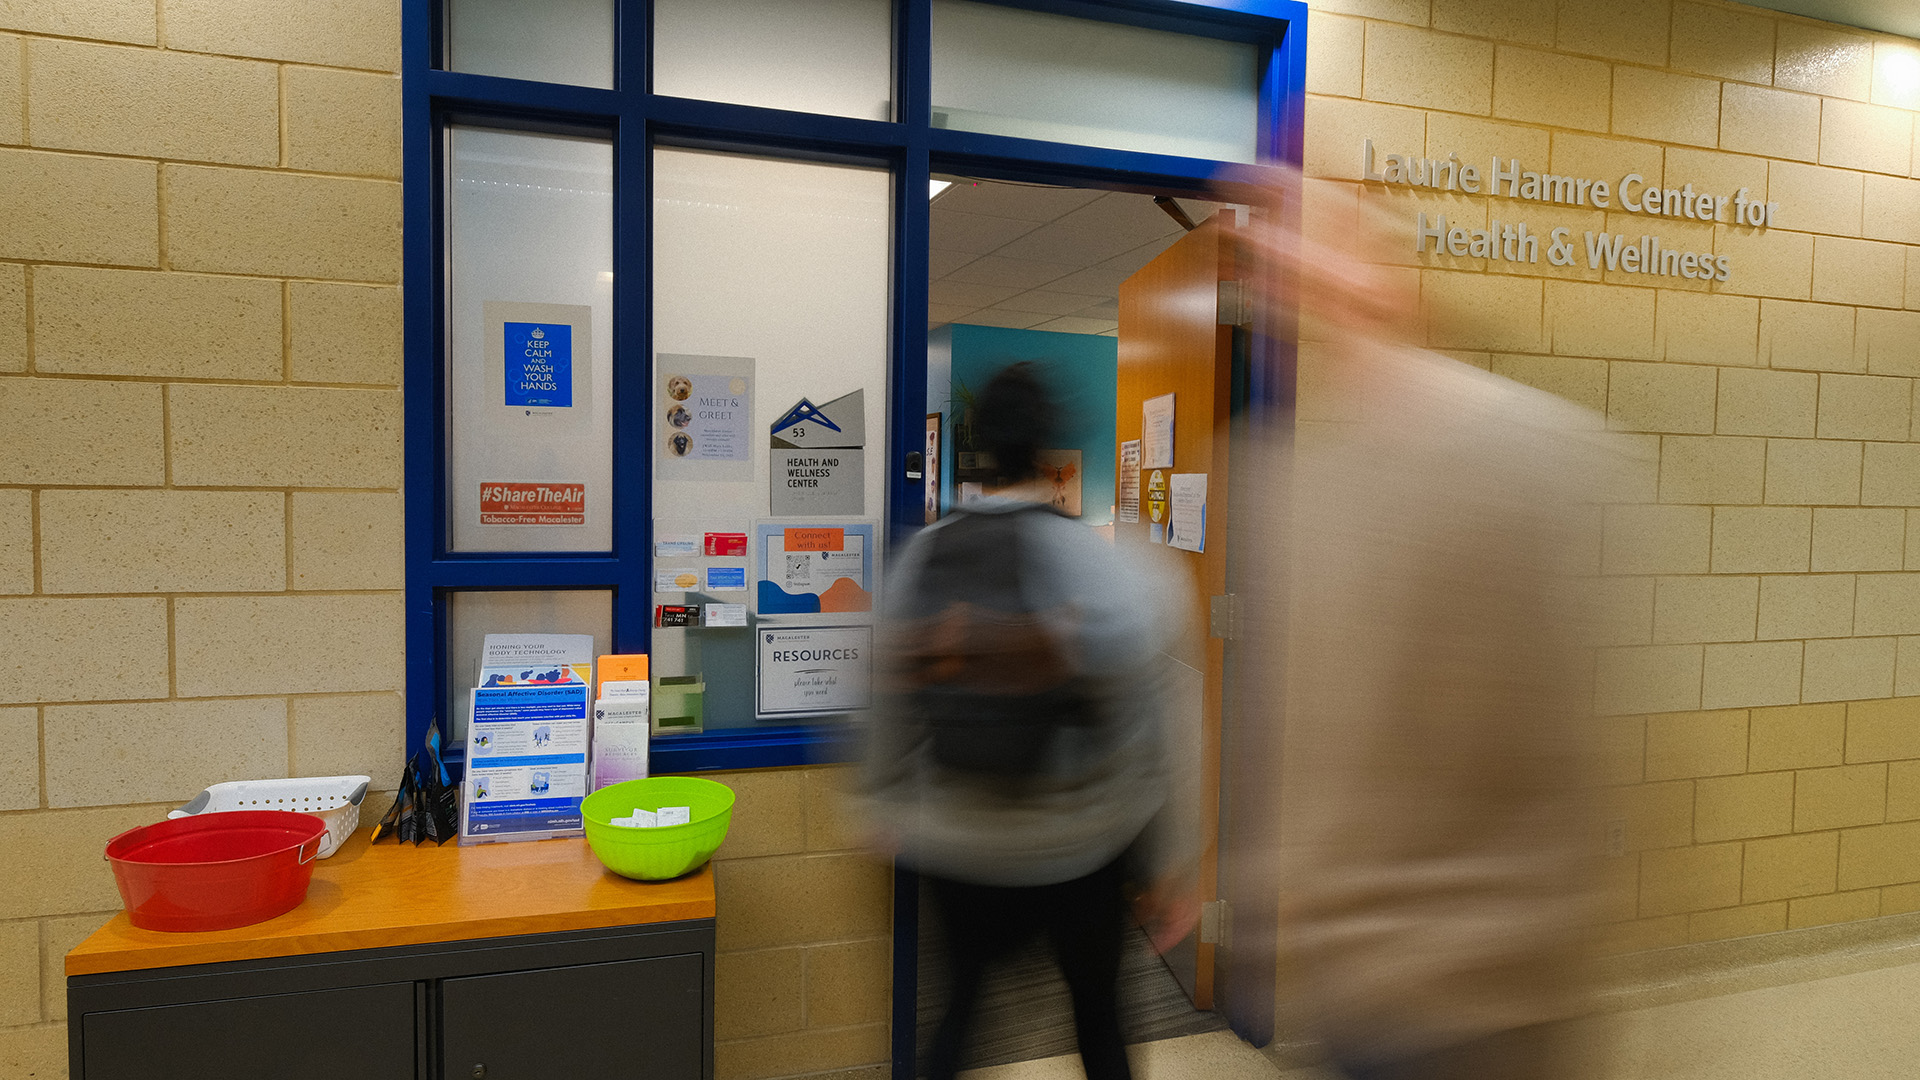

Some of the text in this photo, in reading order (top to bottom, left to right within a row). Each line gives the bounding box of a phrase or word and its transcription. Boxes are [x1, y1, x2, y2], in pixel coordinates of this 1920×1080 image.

[1362, 138, 1778, 227] Laurie Hamre Center for
[1416, 212, 1731, 282] Health & Wellness
[527, 340, 550, 349] KEEP
[524, 349, 552, 358] CALM
[523, 364, 554, 373] WASH
[524, 373, 553, 382] YOUR
[520, 381, 557, 391] HANDS
[699, 397, 739, 407] MEET &
[698, 410, 733, 420] GREET
[792, 427, 805, 438] 53
[787, 458, 839, 468] HEALTH AND
[787, 468, 831, 478] WELLNESS
[787, 479, 819, 488] CENTER
[481, 486, 584, 503] #ShareTheAir
[482, 514, 583, 524] Tobacco-Free Macalester
[794, 531, 831, 540] Connect
[797, 541, 831, 549] with us!
[773, 648, 860, 663] RESOURCES
[477, 690, 506, 698] Seasonal
[508, 689, 536, 697] Affective
[564, 688, 583, 696] (SAD)
[815, 688, 828, 696] need
